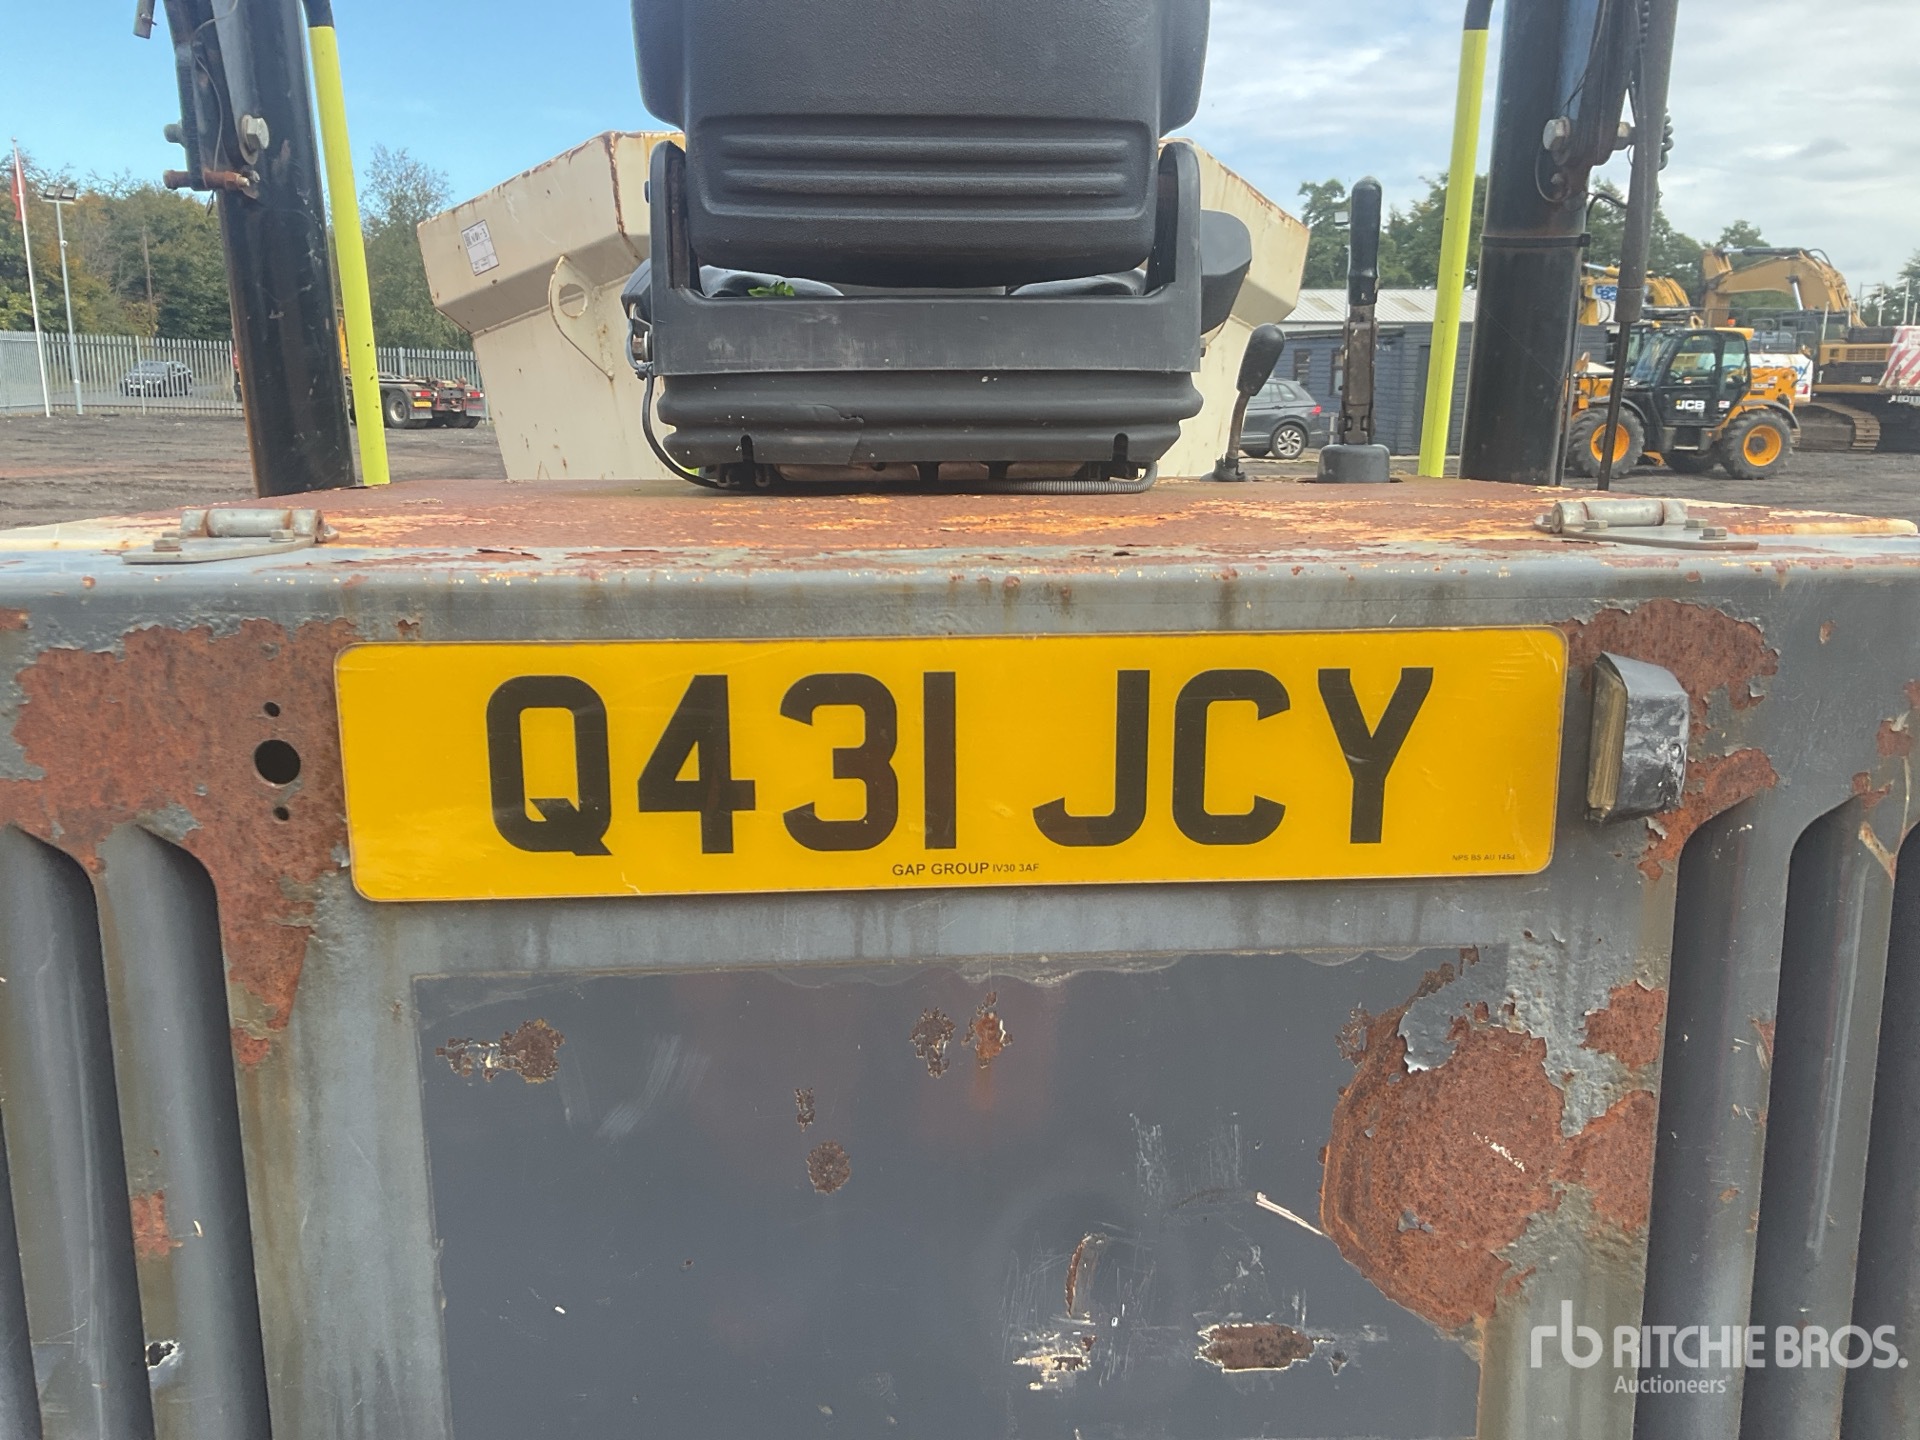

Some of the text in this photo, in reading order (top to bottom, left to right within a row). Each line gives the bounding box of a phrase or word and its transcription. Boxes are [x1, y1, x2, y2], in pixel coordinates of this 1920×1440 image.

[1676, 400, 1705, 410] JCB
[486, 667, 1434, 857] Q431 JCY
[892, 862, 1040, 876] GAP GROUP IV30 3AF
